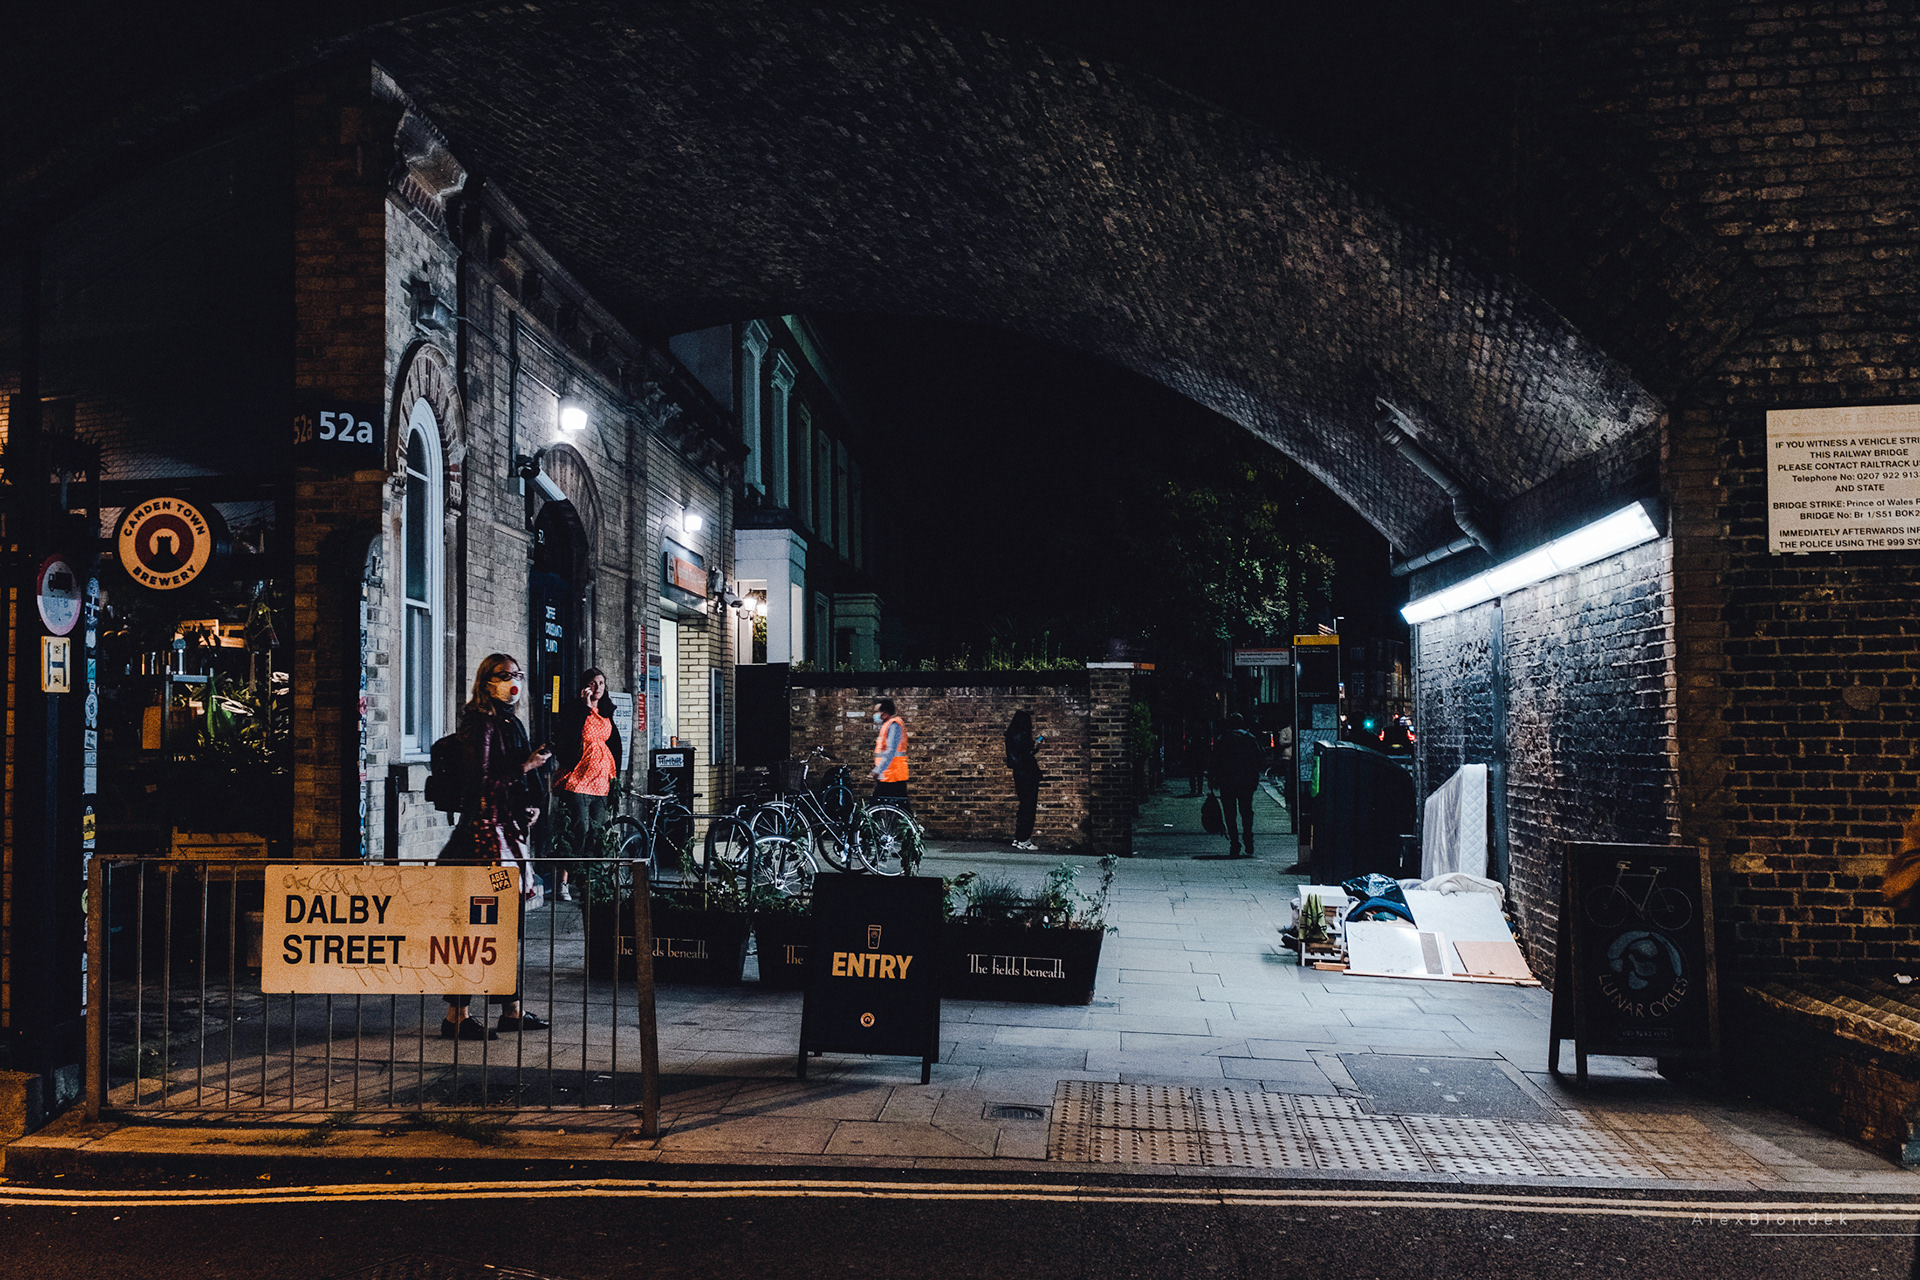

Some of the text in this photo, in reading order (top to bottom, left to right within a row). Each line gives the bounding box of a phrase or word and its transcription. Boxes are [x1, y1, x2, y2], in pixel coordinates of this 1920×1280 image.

[294, 414, 312, 445] 52a
[320, 411, 373, 443] 52a
[1775, 441, 1783, 449] IF
[1806, 439, 1848, 447] WITNESS
[1858, 437, 1897, 446] VEHICLE
[1810, 448, 1909, 459] THIS RAILWAY BRIDGE
[1777, 463, 1812, 471] PLEASE
[1815, 461, 1857, 470] CONTACT
[1860, 460, 1910, 469] RAILTRACK
[1792, 474, 1837, 483] Telephone
[1840, 473, 1855, 481] No:
[1857, 472, 1880, 480] 0207
[1835, 484, 1885, 492] AND STATE
[1773, 501, 1807, 510] BRIDGE
[1809, 500, 1846, 509] STRIKE:
[1847, 499, 1874, 508] Prince
[1876, 499, 1885, 507] of
[1887, 498, 1913, 506] Wales
[124, 501, 205, 537] CAMDEN TOWN
[1800, 511, 1835, 520] BRIDGE
[1779, 529, 1840, 537] IMMEDIATELY
[1842, 527, 1905, 536] AFTERWARDS
[1779, 541, 1797, 549] THE
[1800, 540, 1833, 548] POLICE
[1835, 539, 1864, 547] USING
[1866, 538, 1885, 547] THE
[1887, 538, 1905, 546] 999
[132, 565, 196, 586] BREWERY
[285, 895, 392, 924] DALBY
[283, 935, 497, 966] STREET NW5
[667, 938, 709, 960] beneath
[783, 944, 808, 965] The
[831, 951, 913, 980] ENTRY
[967, 953, 1066, 979] The fields beneath
[1599, 974, 1688, 1018] LUNAR CYCLES
